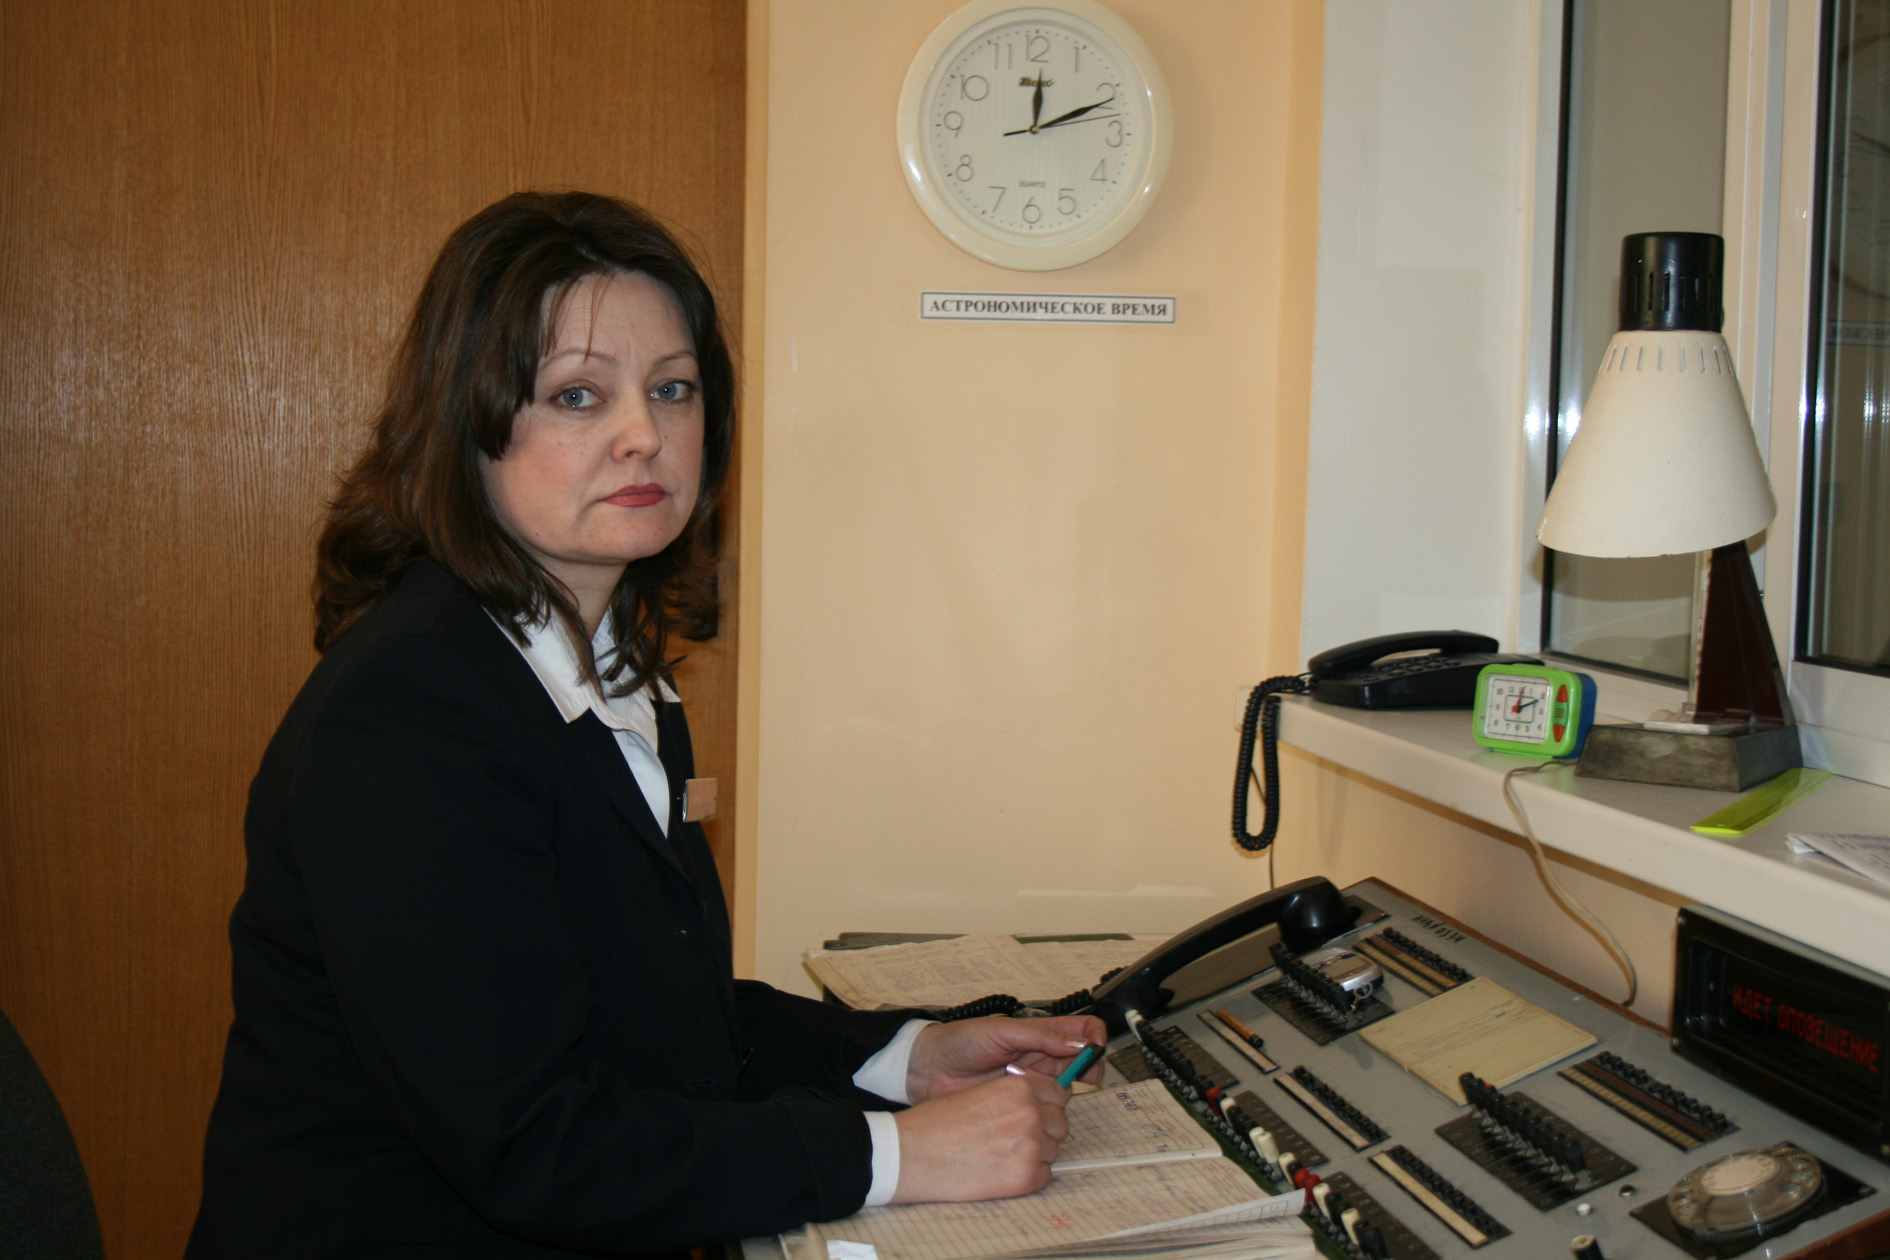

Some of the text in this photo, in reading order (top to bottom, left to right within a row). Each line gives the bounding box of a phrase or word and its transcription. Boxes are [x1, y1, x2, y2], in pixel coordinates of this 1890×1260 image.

[994, 43, 1012, 71] 11
[1026, 35, 1049, 63] 12
[1073, 46, 1080, 73] 1
[960, 74, 989, 102] 10
[1096, 82, 1116, 110] 2
[943, 110, 964, 139] 9
[1105, 120, 1123, 148] 3
[955, 154, 974, 182] 8
[1090, 158, 1108, 182] 4
[988, 186, 1006, 213] 7
[1022, 196, 1041, 224] 6
[1057, 188, 1076, 216] 5
[929, 299, 1168, 316] АСТРОНОМИЧЕСКОЕ ВРЕМЯ
[1733, 984, 1881, 1073] ИДЕТ ОПОВЕЩЕНИЕ
